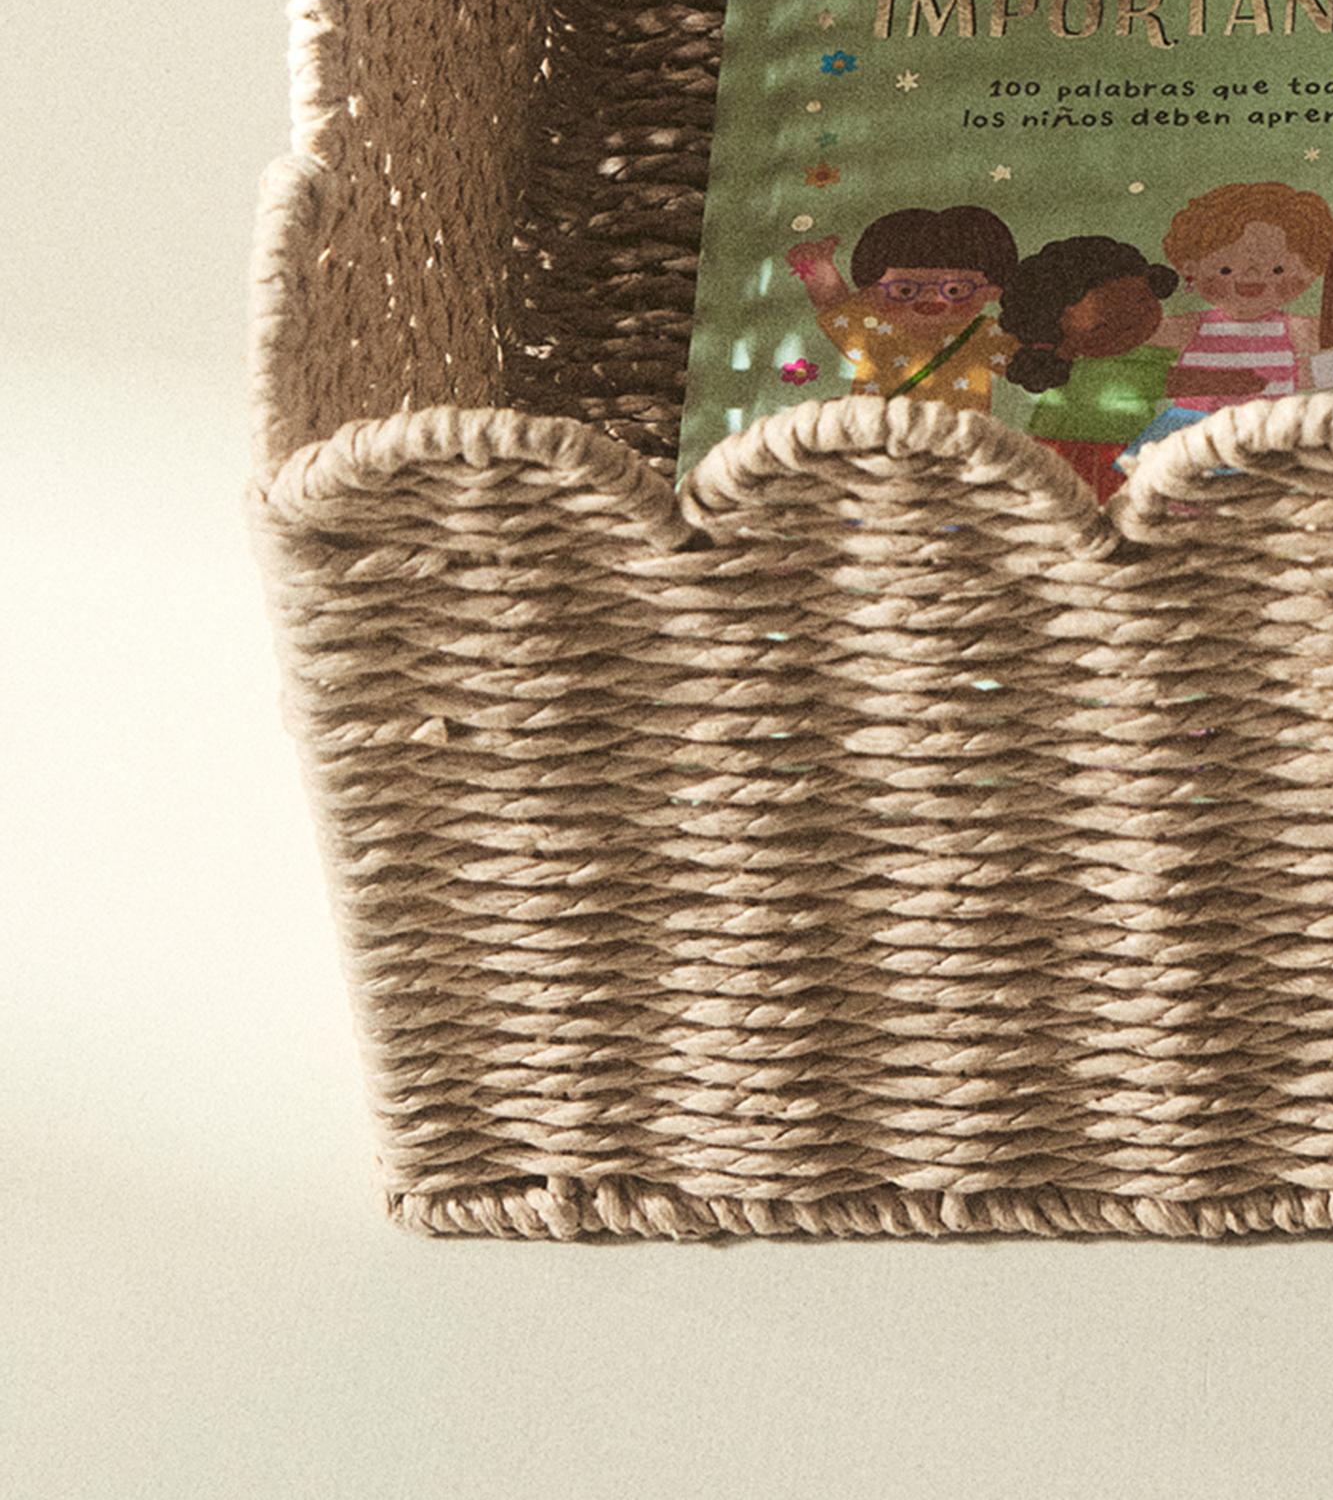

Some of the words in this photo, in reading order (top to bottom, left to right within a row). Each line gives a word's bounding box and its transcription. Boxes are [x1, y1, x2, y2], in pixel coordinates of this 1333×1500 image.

[989, 79, 1041, 98] 100
[1057, 79, 1195, 102] palabras
[1212, 79, 1270, 101] que
[962, 109, 1006, 129] los
[1021, 106, 1114, 129] niños
[1130, 107, 1231, 128] deben
